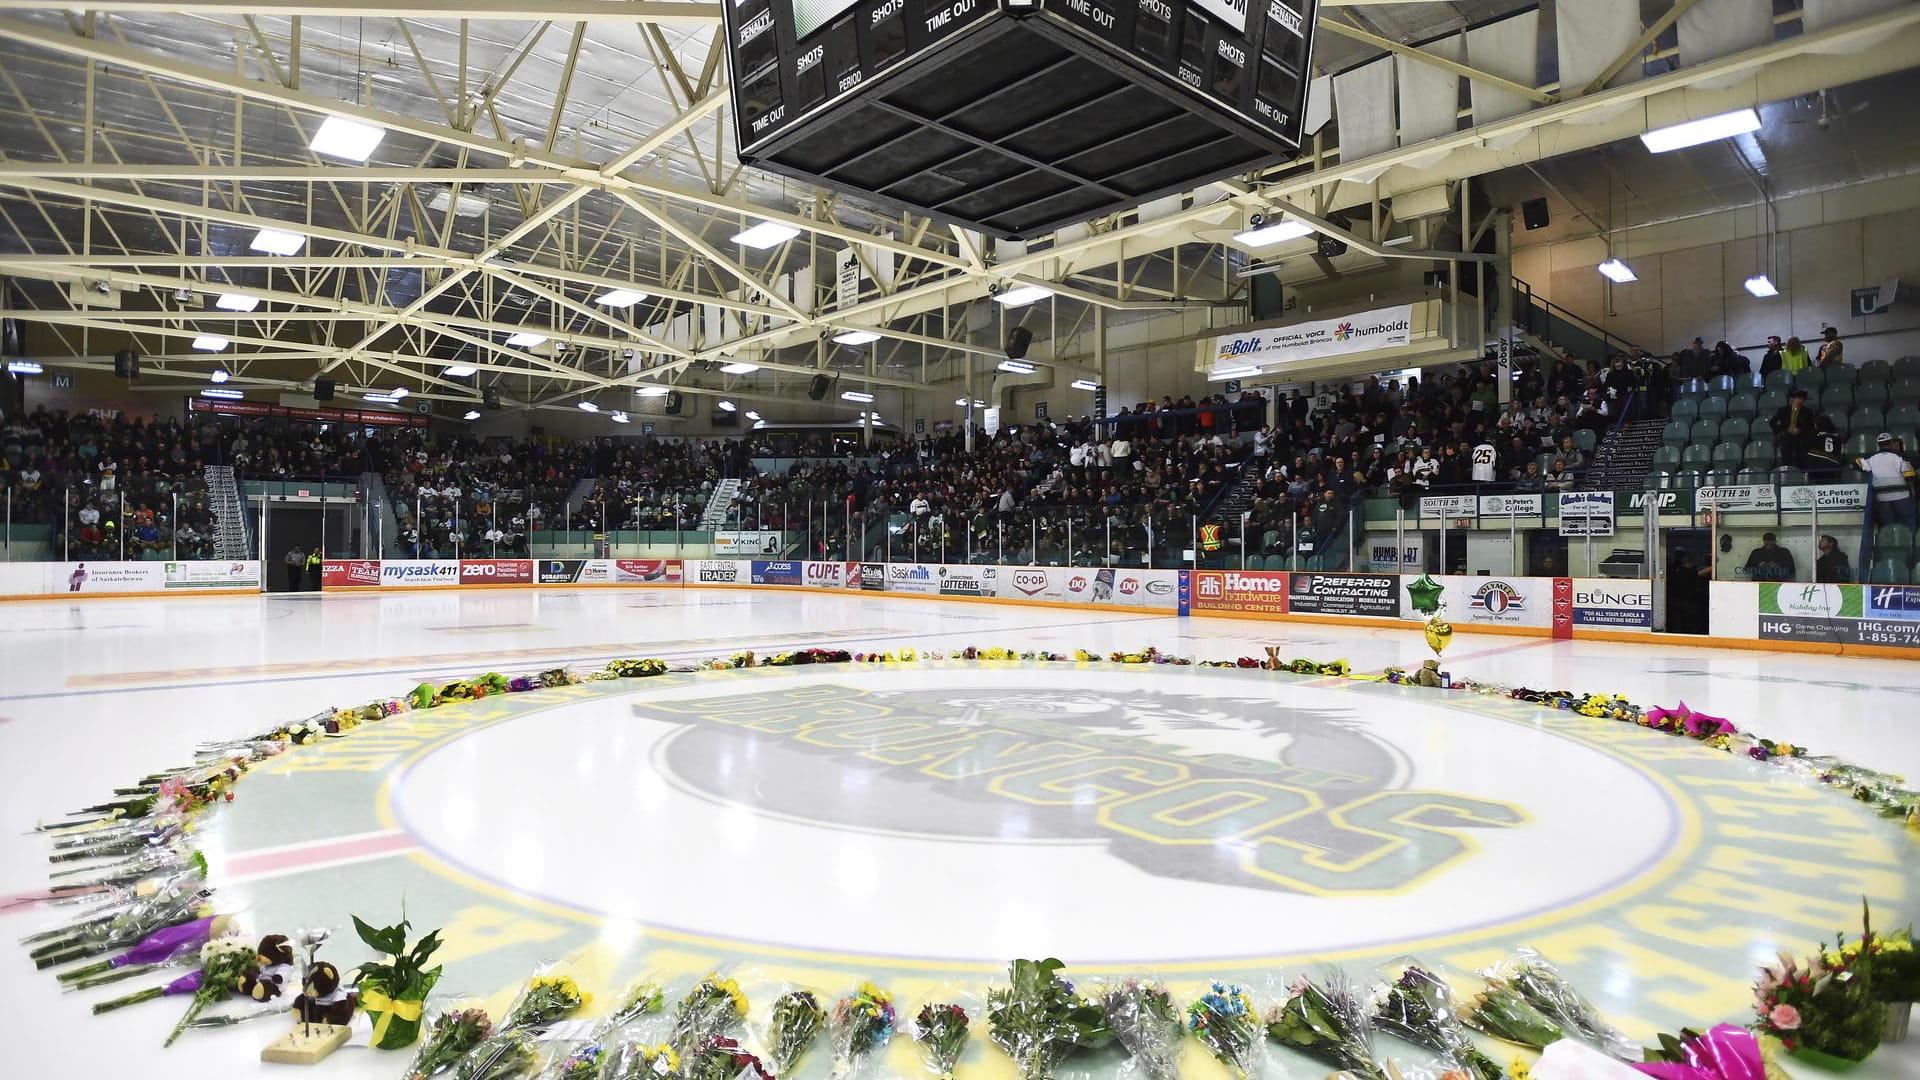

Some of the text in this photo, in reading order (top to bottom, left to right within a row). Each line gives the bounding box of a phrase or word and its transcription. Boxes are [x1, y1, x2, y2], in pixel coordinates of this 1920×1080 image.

[872, 0, 904, 23] SHOTS
[926, 0, 977, 33] TIME OUT
[1065, 0, 1115, 30] TIME OUT
[1139, 0, 1171, 20] SHOTS
[1271, 3, 1302, 31] PENALTY
[740, 13, 771, 41] PENALTY
[797, 45, 824, 70] SHOTS
[1219, 40, 1245, 64] SHOTS
[839, 71, 862, 92] PERIOD
[1179, 68, 1201, 87] PERIOD
[1255, 99, 1288, 125] TIME OUT
[752, 105, 785, 133] TIME OUT
[1860, 296, 1876, 314] U
[1355, 320, 1409, 338] humboldt
[1274, 330, 1326, 343] OFFICIAL VOICE
[1282, 340, 1309, 349] Humboldt
[1309, 337, 1332, 347] Broncos
[1232, 338, 1261, 356] Bolt
[57, 377, 70, 388] M
[1229, 381, 1238, 392] S
[1824, 437, 1834, 453] 6
[1474, 449, 1492, 465] 25
[1701, 489, 1751, 498] SOUTH 20
[1829, 489, 1860, 497] Peter's
[1423, 498, 1460, 507] SOUTH 20
[1755, 501, 1774, 509] Jeep
[1818, 497, 1860, 506] College
[732, 538, 762, 546] VKING
[1373, 547, 1418, 558] HUMBDT
[462, 563, 496, 577] zero
[701, 570, 736, 581] TRADER
[807, 563, 840, 579] CUPE
[940, 580, 979, 590] LOTTERIES
[1072, 580, 1084, 589] DQ
[1122, 581, 1136, 591] DQ
[1223, 573, 1281, 592] Home
[1312, 576, 1391, 588] PREFERRED
[1224, 591, 1281, 603] hardware
[1313, 586, 1389, 597] CONTRACTING
[1576, 593, 1651, 606] BUNGE
[1197, 602, 1282, 612] BUILDING CENTRE
[1789, 603, 1817, 613] Holiday
[1763, 622, 1792, 634] IHG
[1816, 624, 1849, 633] Changing
[640, 683, 1533, 896] BRONCOS
[1440, 774, 1905, 1062] PETERSE
